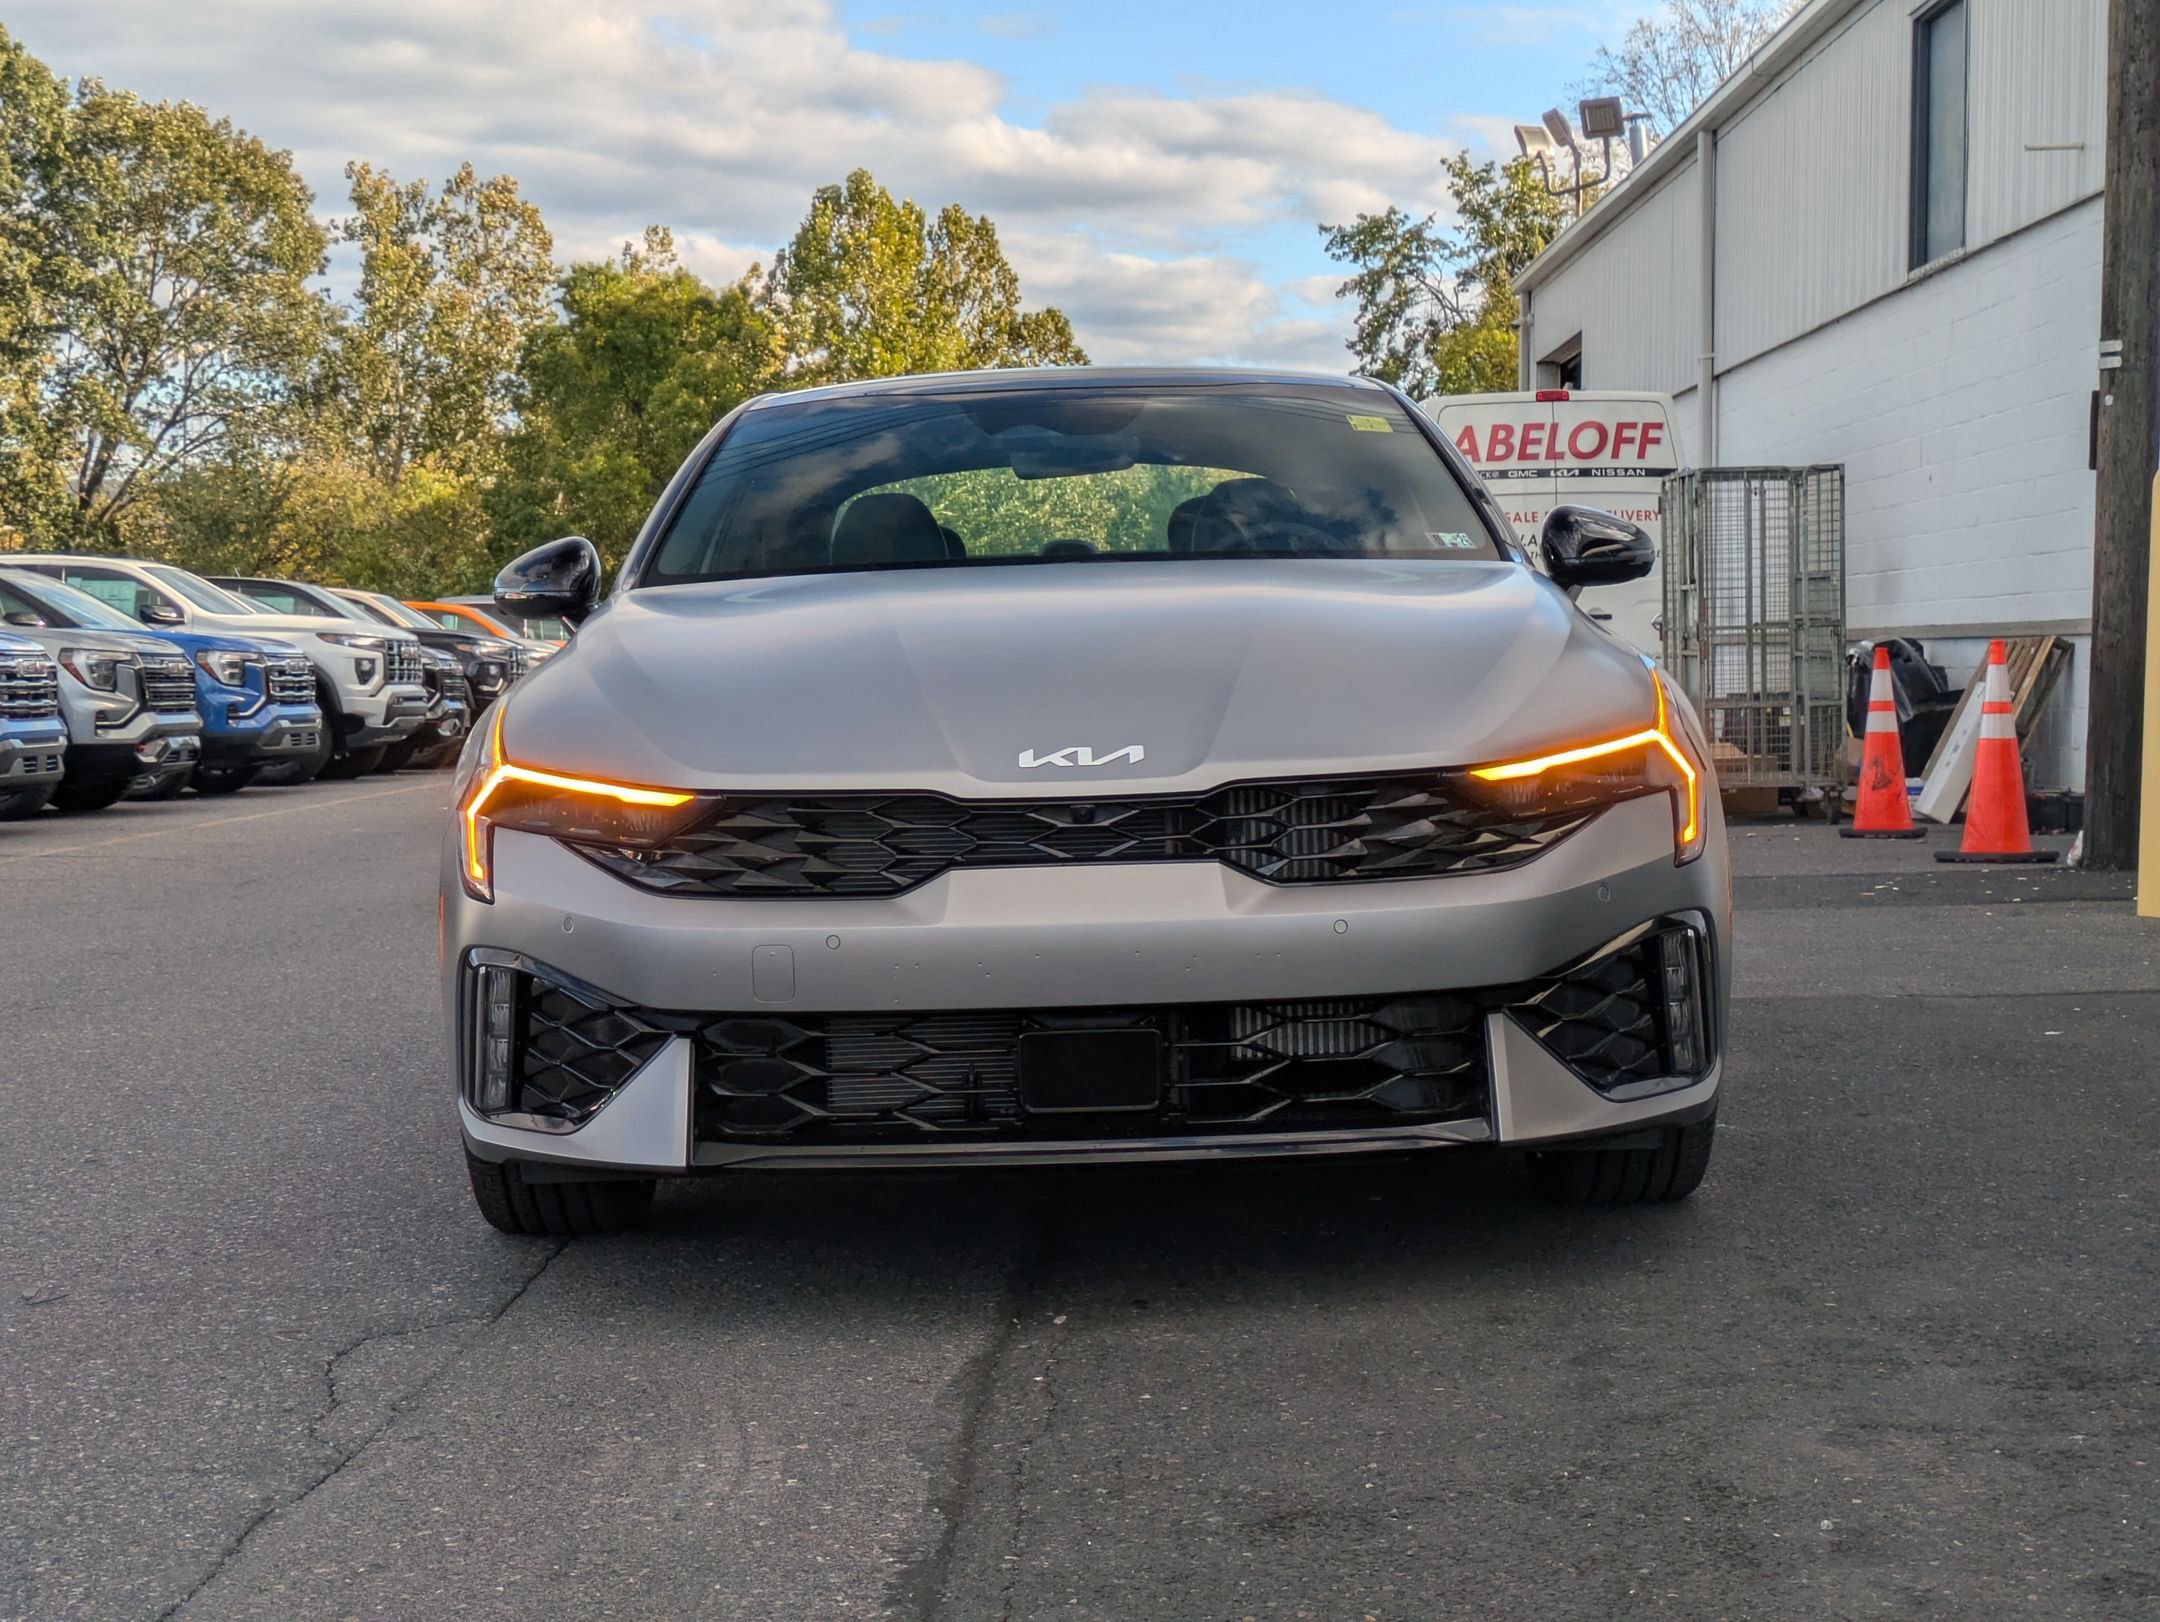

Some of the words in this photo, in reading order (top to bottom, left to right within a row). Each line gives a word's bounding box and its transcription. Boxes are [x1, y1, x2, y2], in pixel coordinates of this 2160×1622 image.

[1456, 420, 1664, 463] ABELOFF
[1508, 469, 1538, 478] GMC
[1549, 468, 1580, 477] KIA
[1591, 468, 1646, 477] NISSAN
[1018, 745, 1144, 767] KIA
